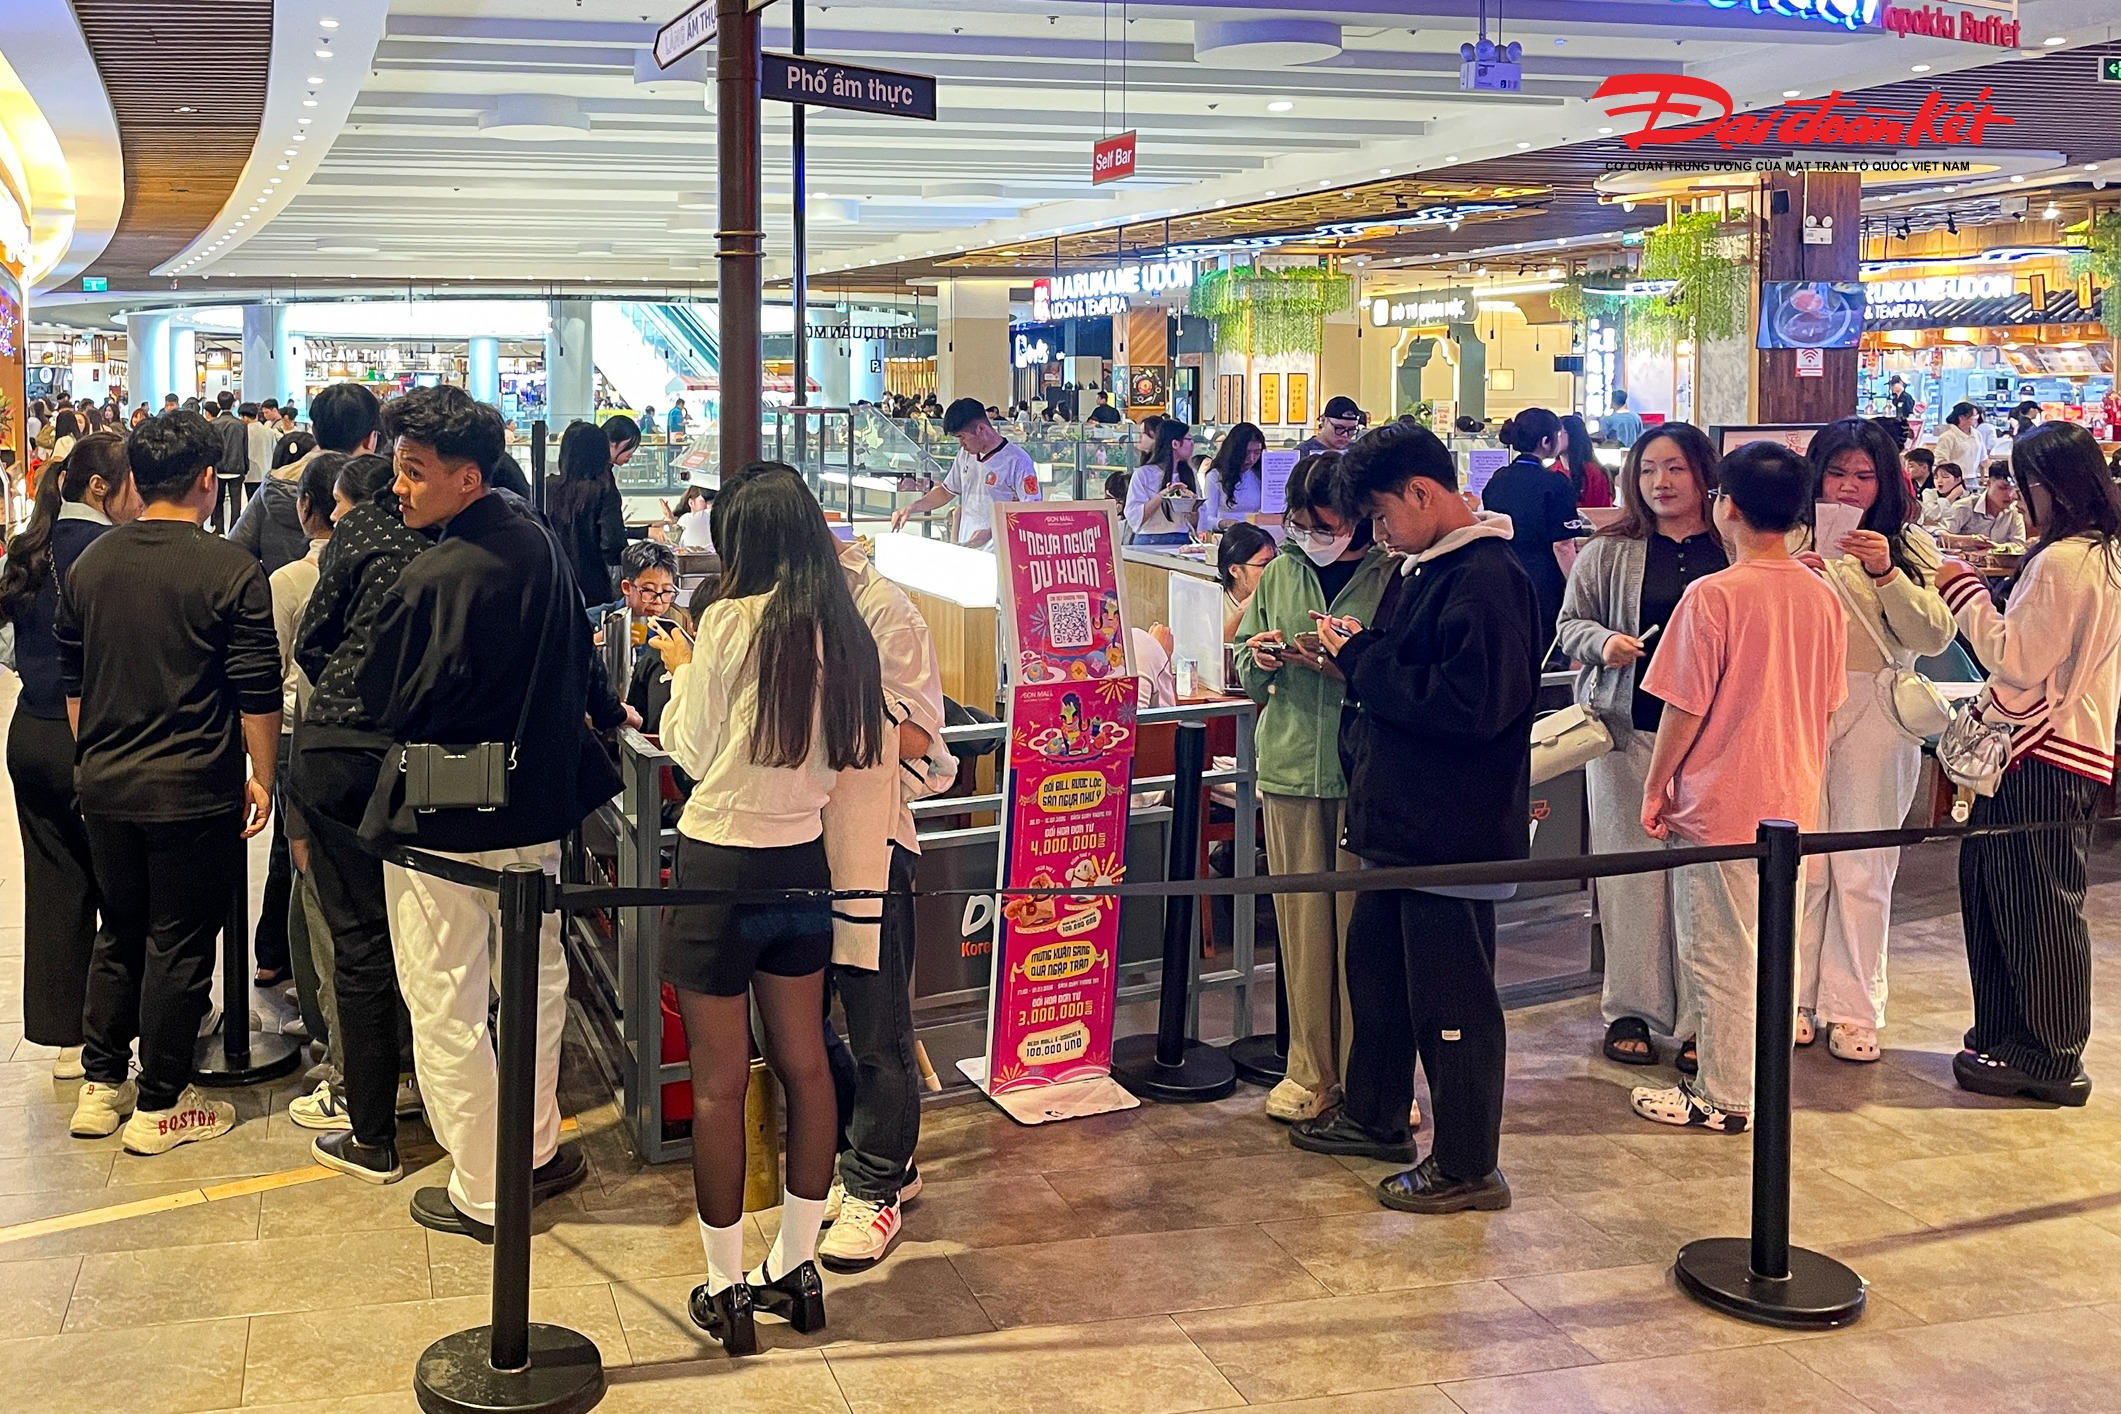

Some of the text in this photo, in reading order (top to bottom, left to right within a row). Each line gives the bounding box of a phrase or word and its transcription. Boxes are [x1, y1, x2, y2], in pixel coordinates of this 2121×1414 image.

[1960, 10, 2020, 48] Buffet
[787, 65, 914, 108] Phố ẩm thực
[1095, 148, 1133, 171] Self Bar
[1050, 261, 1194, 301] MARUKAME UDON
[1948, 275, 2014, 300] UDON
[1050, 299, 1078, 320] UDON
[1085, 295, 1128, 317] TEMPURA
[1875, 303, 1927, 319] TEMPURA
[1055, 556, 1101, 588] XUÂN
[961, 941, 991, 958] Kore
[158, 1109, 217, 1136] BOSTON
